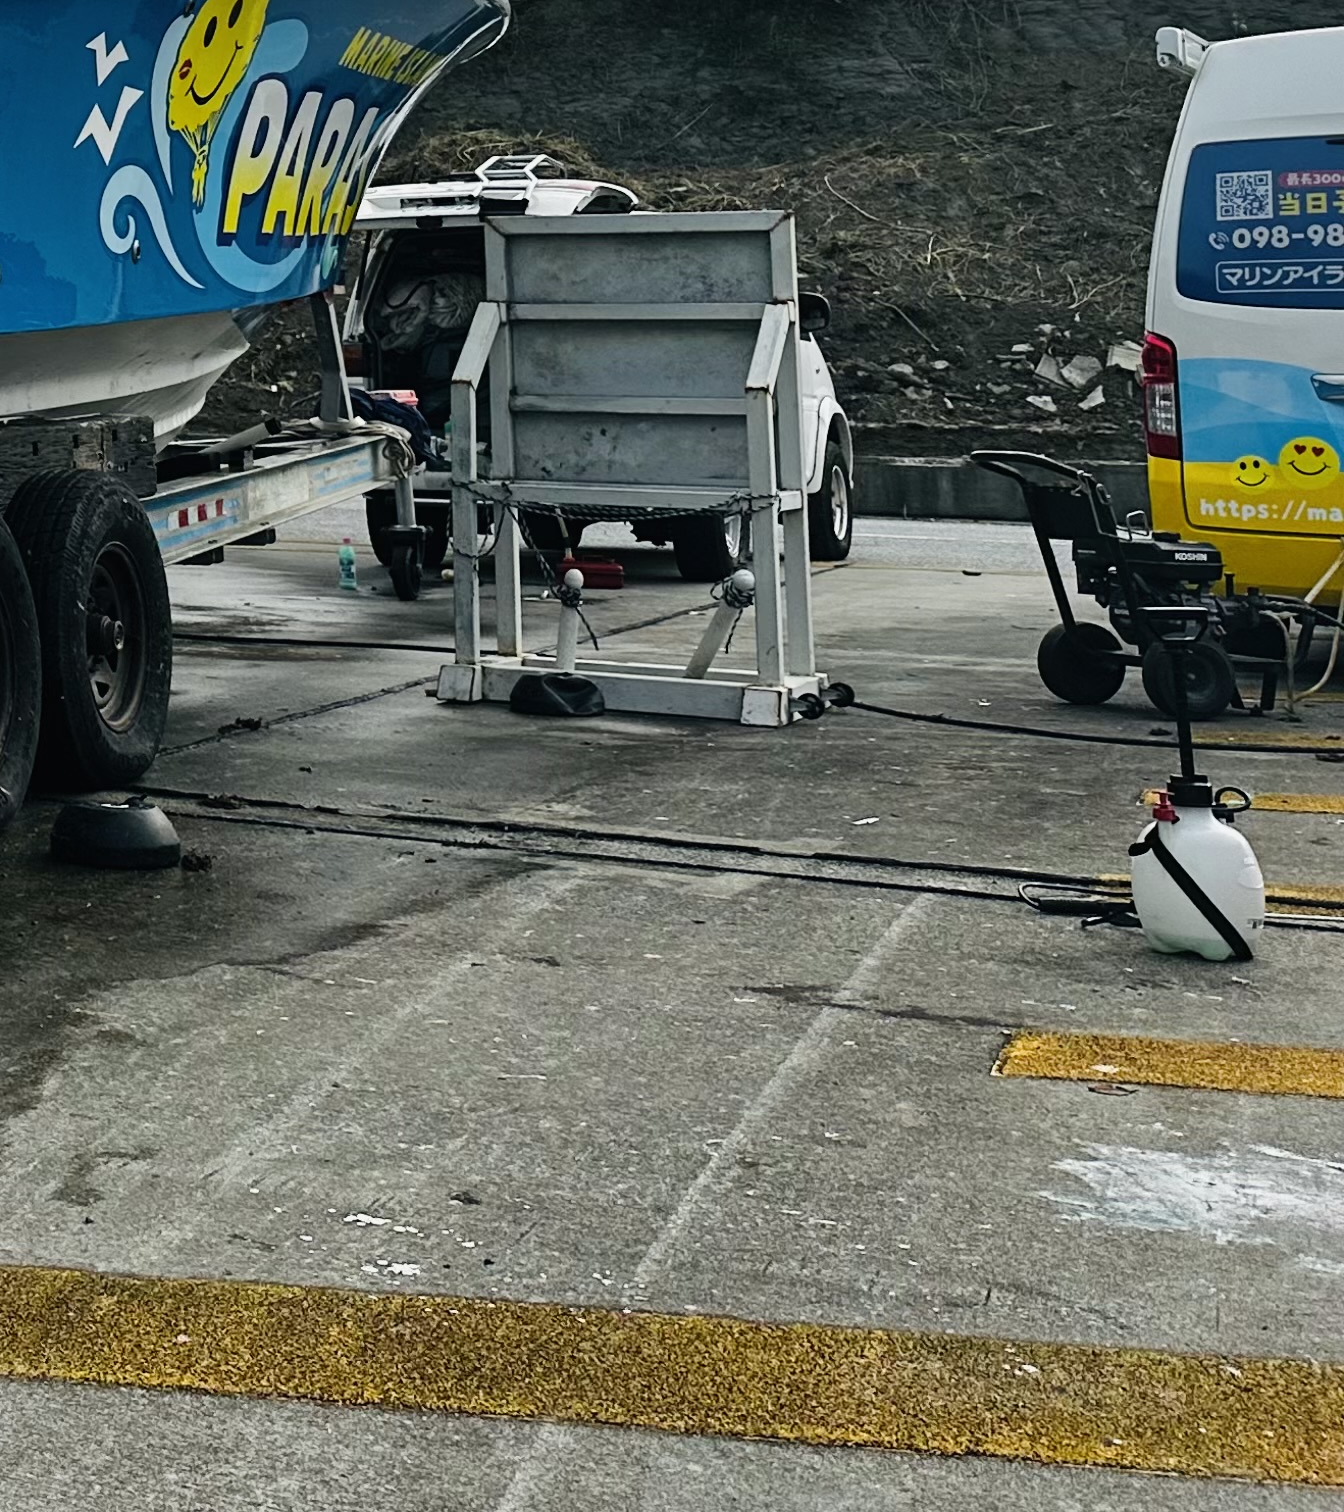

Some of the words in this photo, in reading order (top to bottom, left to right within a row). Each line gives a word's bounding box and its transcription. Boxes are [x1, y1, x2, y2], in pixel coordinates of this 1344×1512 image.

[337, 26, 414, 81] MARINE
[1286, 172, 1344, 186] 最長300
[1174, 552, 1208, 562] KOSHIN
